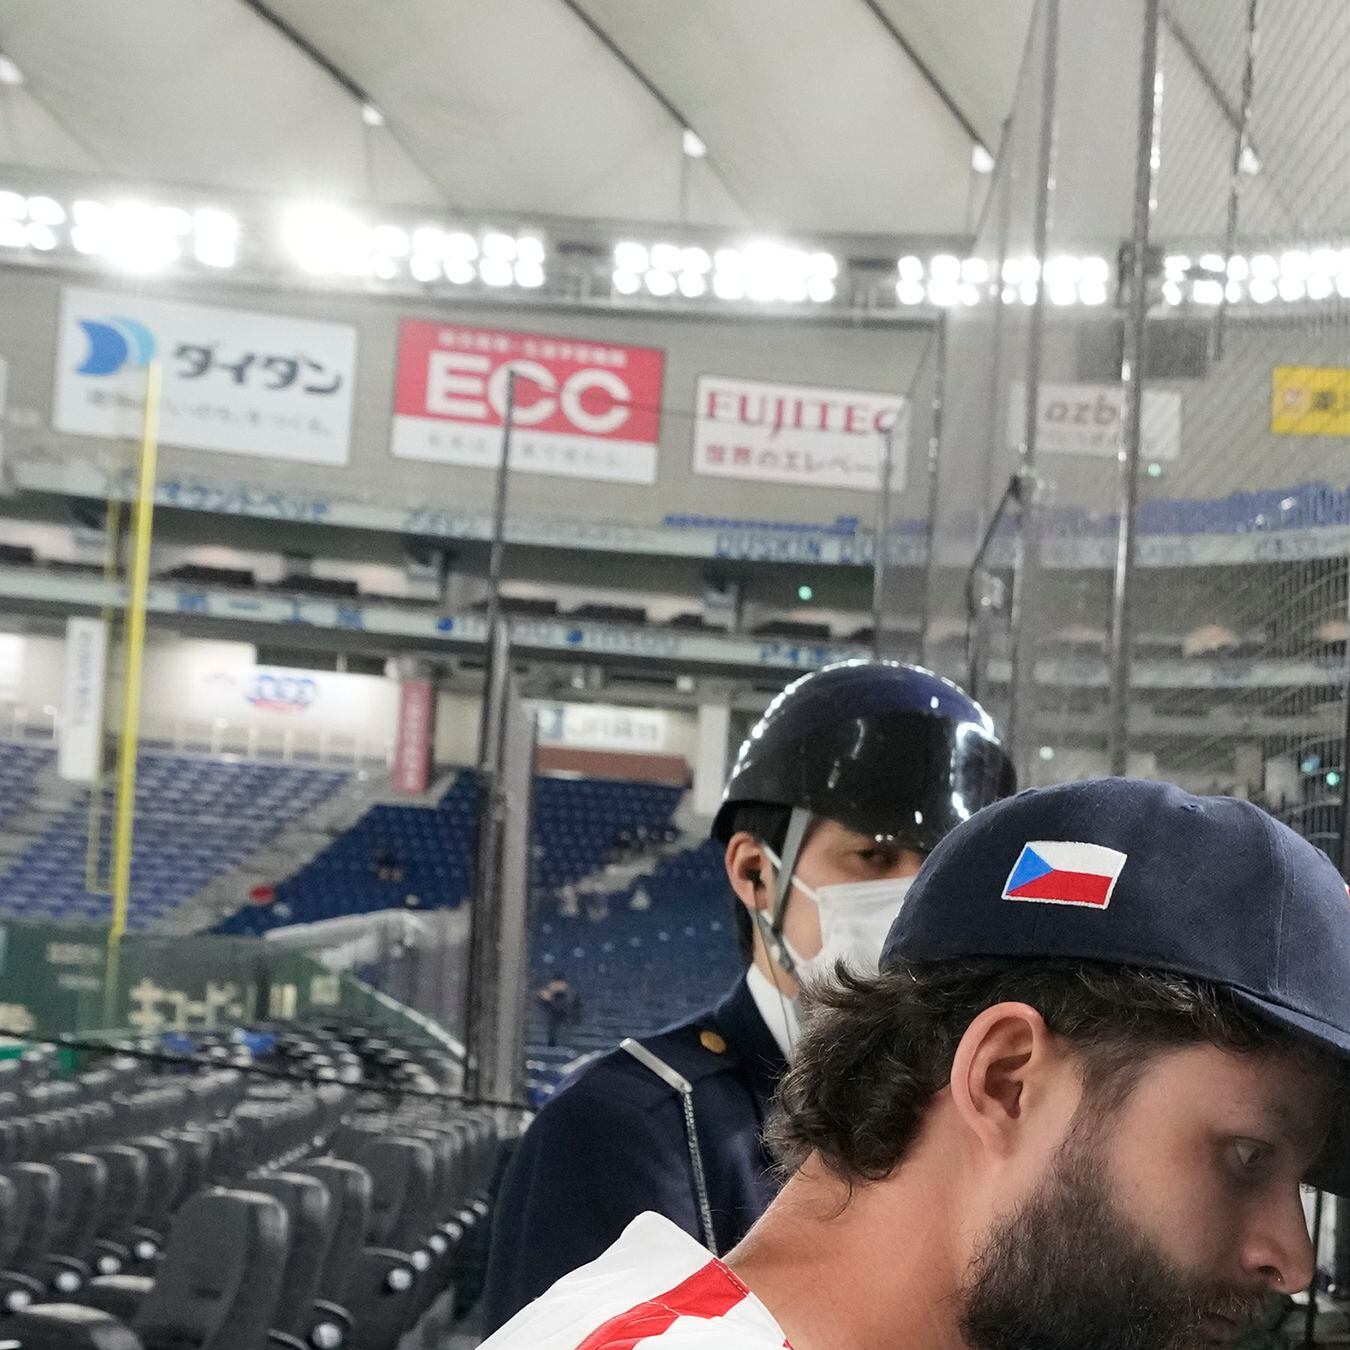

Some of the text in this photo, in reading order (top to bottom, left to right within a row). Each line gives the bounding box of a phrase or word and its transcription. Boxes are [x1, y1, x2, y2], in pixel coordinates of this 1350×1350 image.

[173, 341, 343, 395] ダイダン
[425, 349, 633, 434] ECC
[707, 390, 897, 438] FUJITEC
